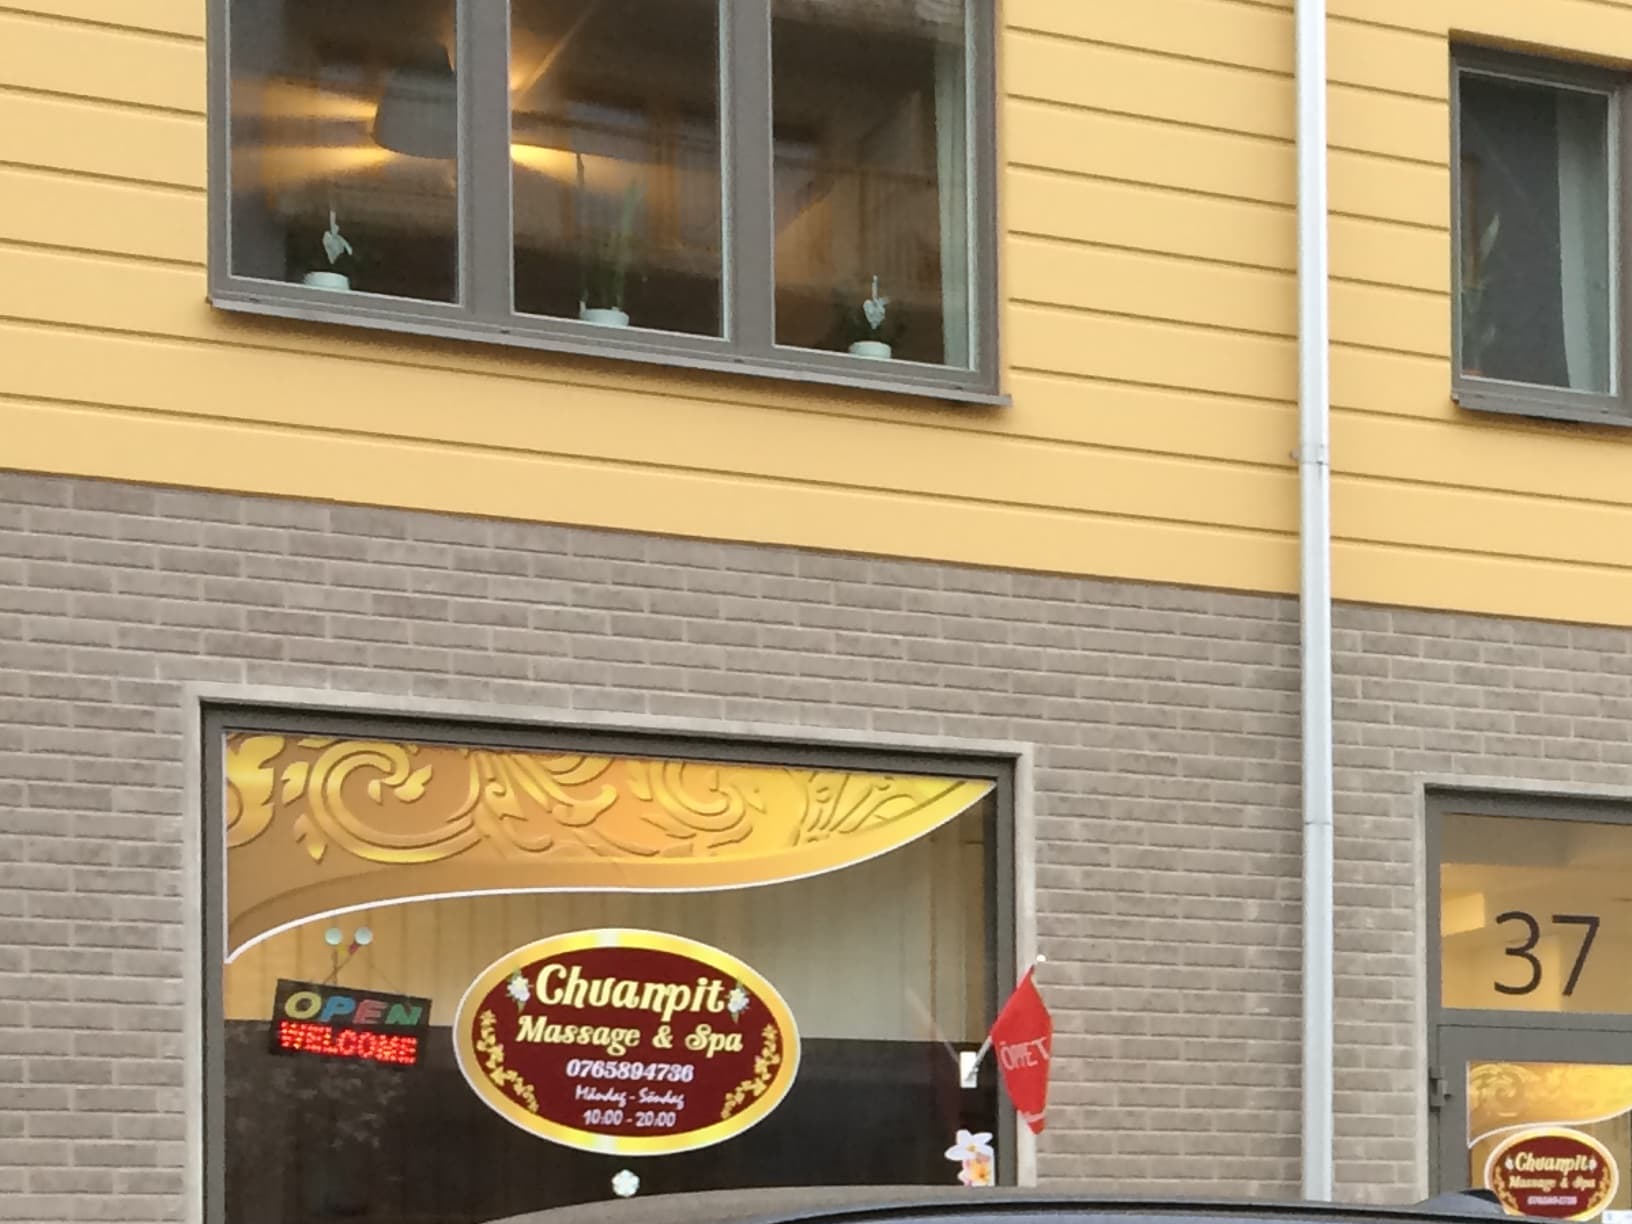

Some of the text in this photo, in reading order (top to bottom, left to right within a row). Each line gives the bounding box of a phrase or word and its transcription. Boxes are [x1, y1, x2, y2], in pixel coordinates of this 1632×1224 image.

[1493, 911, 1600, 997] 37
[284, 991, 422, 1025] OPEN
[535, 963, 726, 1022] Chuanpit
[515, 1015, 743, 1058] Massage & Spa
